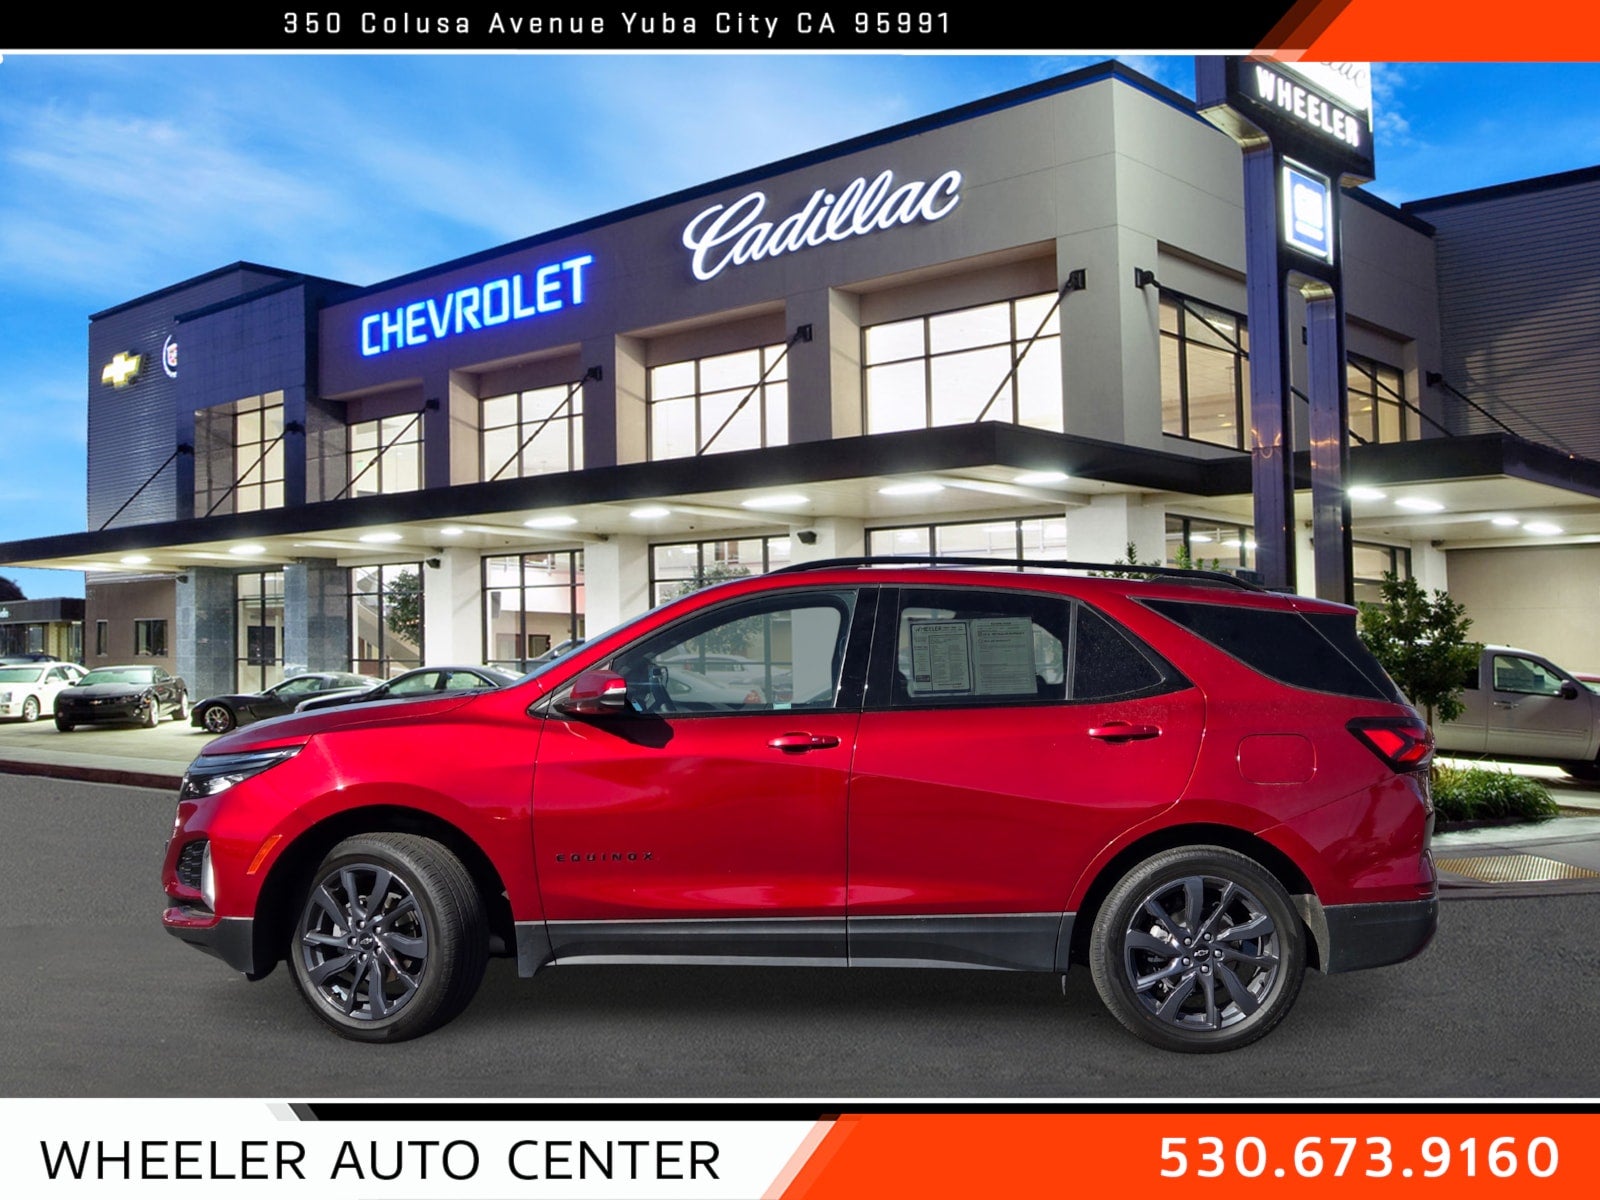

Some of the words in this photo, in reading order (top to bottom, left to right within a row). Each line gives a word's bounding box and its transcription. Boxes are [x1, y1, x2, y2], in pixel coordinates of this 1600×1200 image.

[1255, 65, 1361, 148] WHEELER
[682, 169, 962, 281] Cadillac
[361, 254, 594, 357] CHEVROLET
[555, 852, 653, 862] EQUINOX
